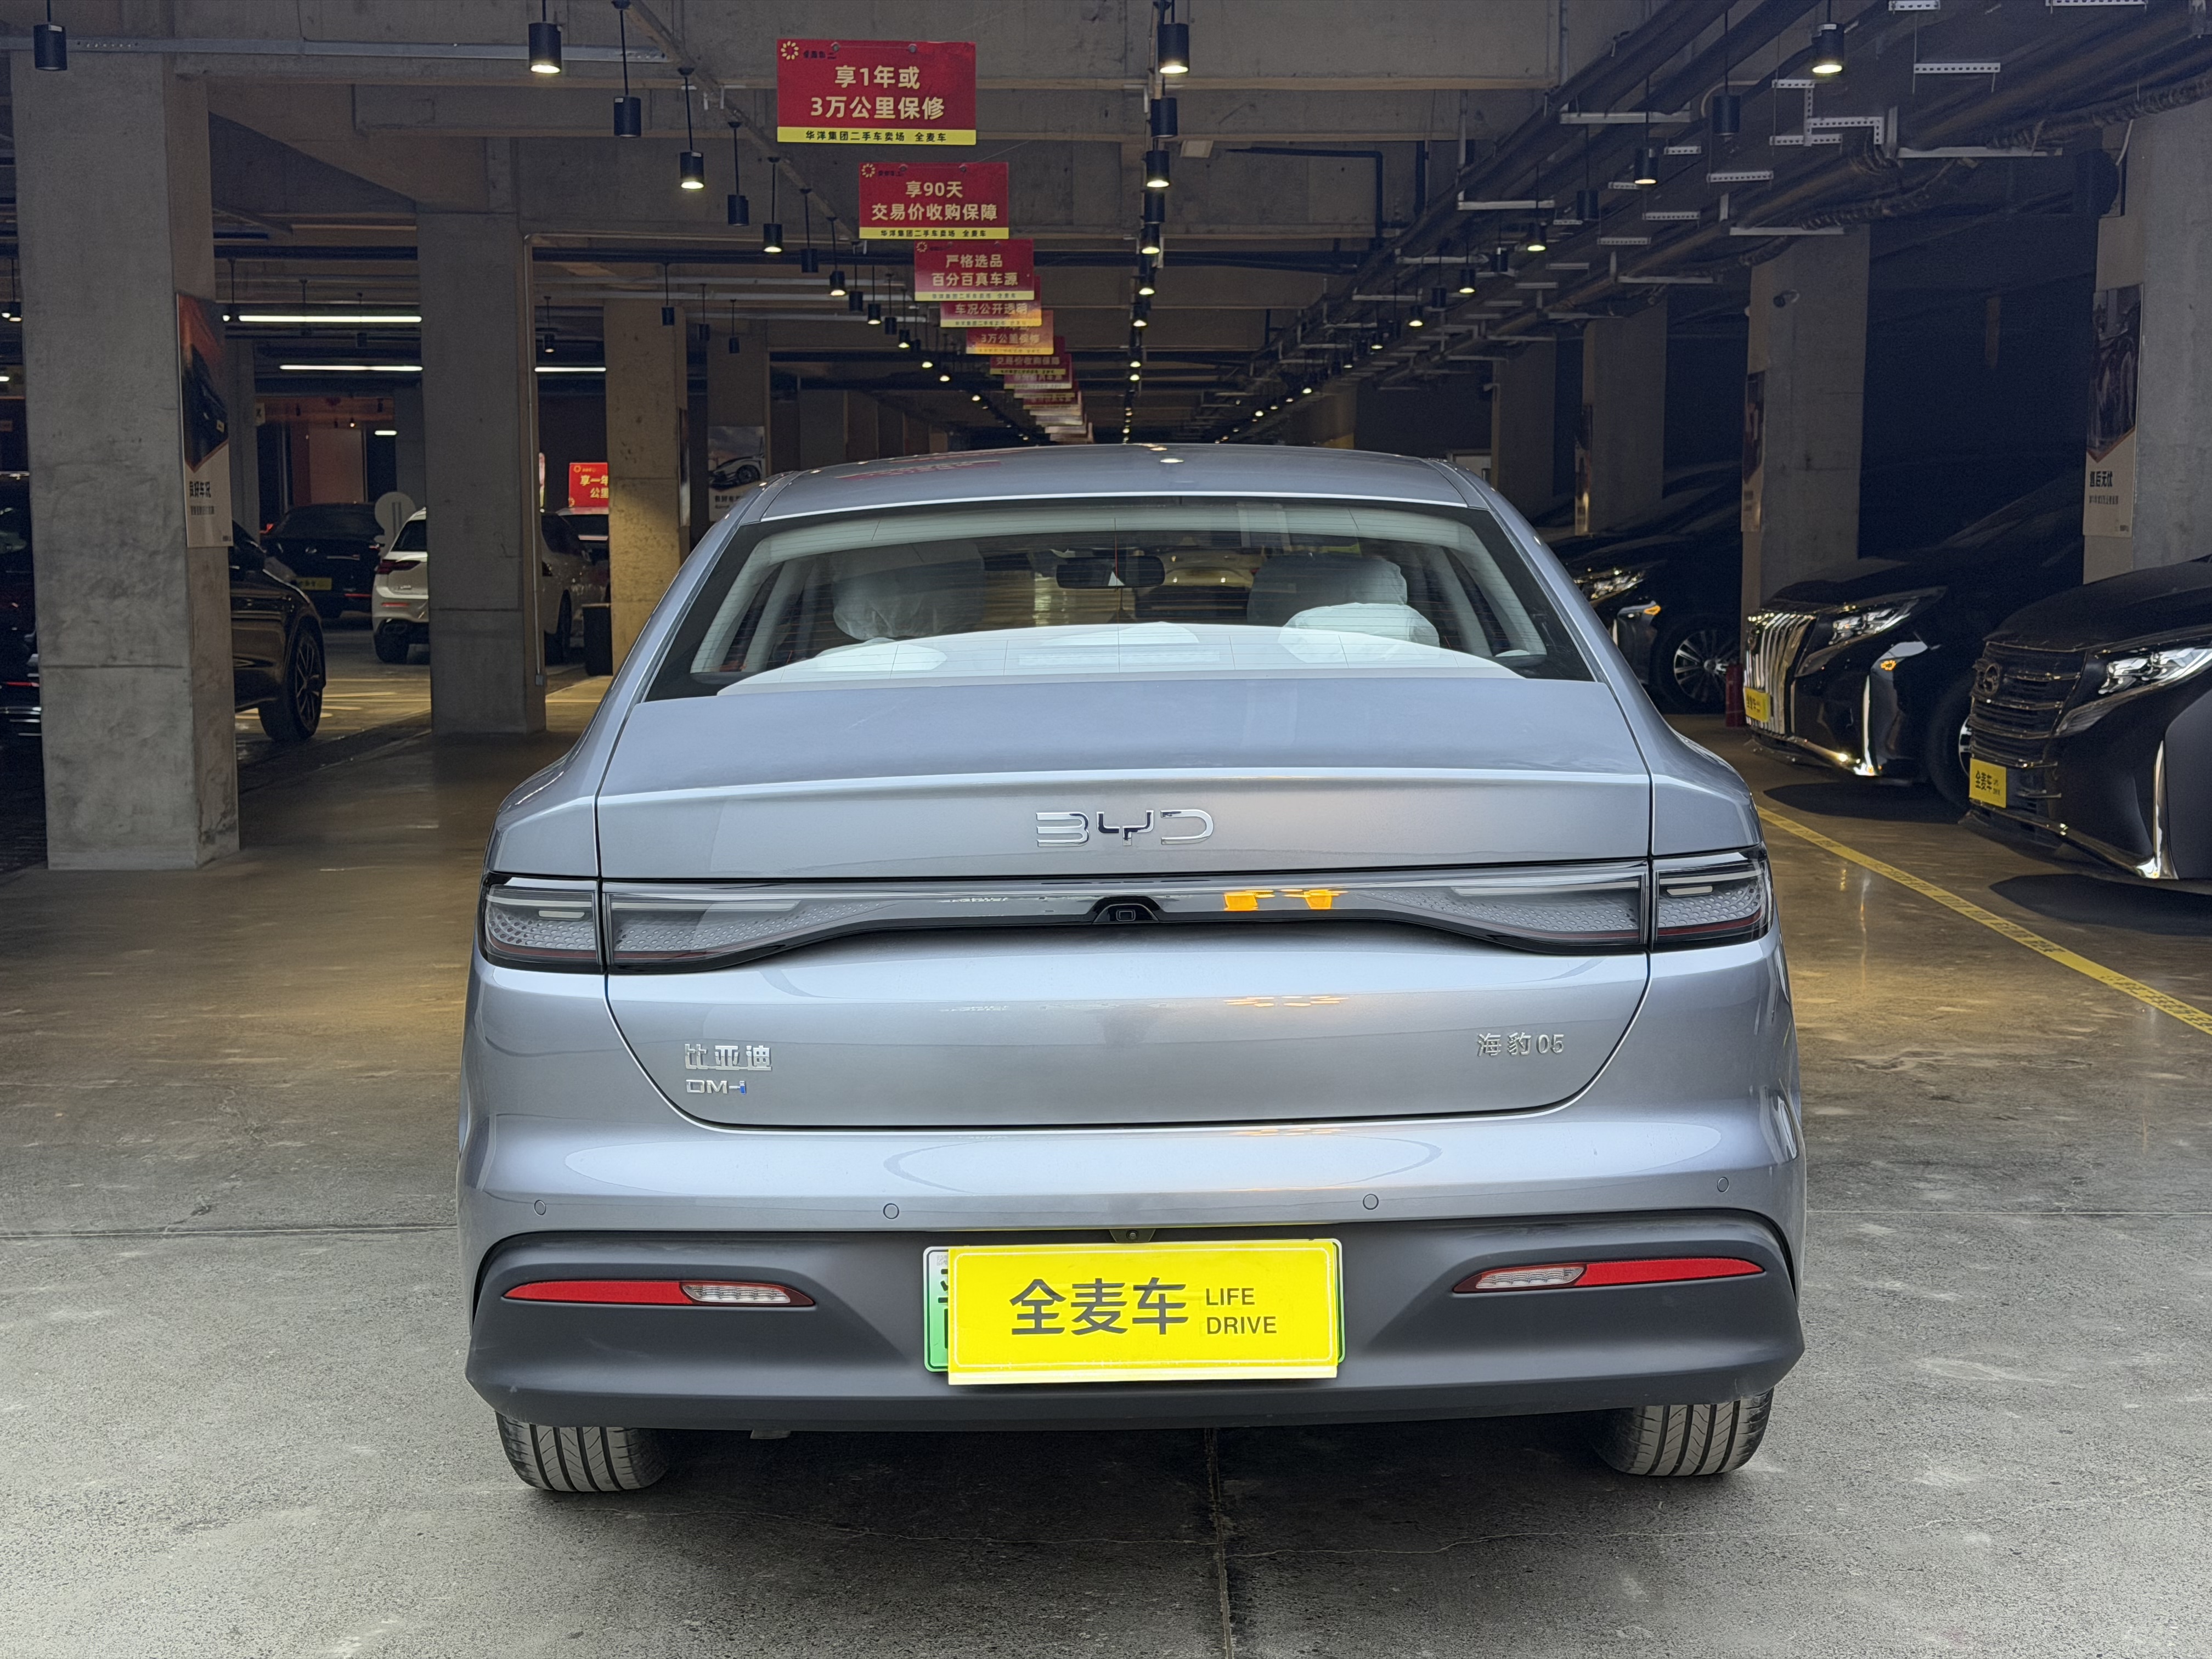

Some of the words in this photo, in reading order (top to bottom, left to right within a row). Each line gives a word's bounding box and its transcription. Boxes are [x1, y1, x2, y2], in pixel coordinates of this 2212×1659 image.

[834, 65, 920, 89] 享1年或
[811, 95, 945, 121] 3万公里保修
[805, 131, 905, 143] 华洋集团二手车卖场
[914, 132, 947, 143] 全麦车
[905, 180, 964, 199] 享90天
[871, 204, 998, 222] 交易价收购保障
[945, 253, 1003, 269] 严格选品
[932, 272, 1019, 287] 百分百真车源
[1035, 809, 1214, 848] BYD
[1476, 1031, 1565, 1057] 海豹05
[684, 1043, 773, 1071] 比亚迪
[685, 1079, 747, 1095] DM-i
[1009, 1276, 1189, 1336] 全麦车
[1205, 1287, 1256, 1306] LIFE
[1206, 1316, 1277, 1334] DRIVE
